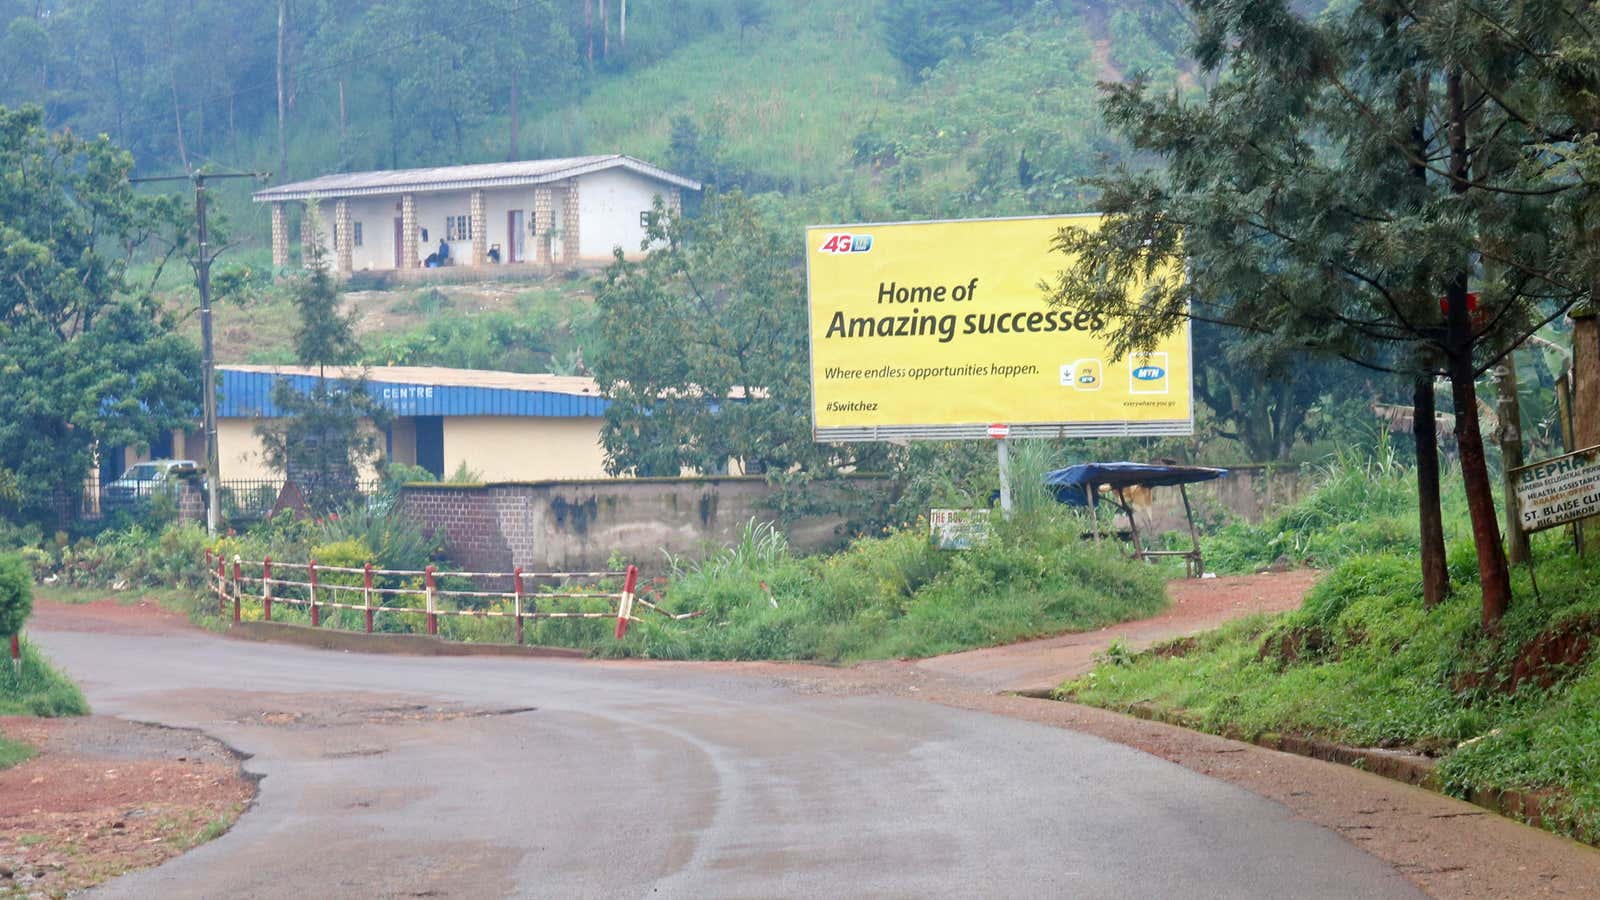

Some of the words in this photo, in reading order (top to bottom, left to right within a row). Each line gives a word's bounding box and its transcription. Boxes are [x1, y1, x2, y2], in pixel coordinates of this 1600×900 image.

[823, 235, 851, 252] 4G
[877, 282, 946, 304] Home
[951, 278, 978, 302] of
[825, 307, 956, 343] Amazing
[962, 309, 1106, 335] successes
[825, 367, 862, 380] Where
[864, 366, 905, 378] endless
[908, 363, 988, 380] opportunities
[990, 363, 1039, 378] happen.
[1138, 368, 1160, 378] MTN
[383, 387, 433, 399] CENTRE
[826, 400, 878, 412] #Switchez
[1527, 487, 1556, 500] HEALTH
[931, 511, 945, 524] THE
[1524, 510, 1540, 522] ST.
[1543, 499, 1580, 517] BLAISE
[1537, 518, 1552, 529] BIG
[1555, 505, 1595, 521] MANKON
